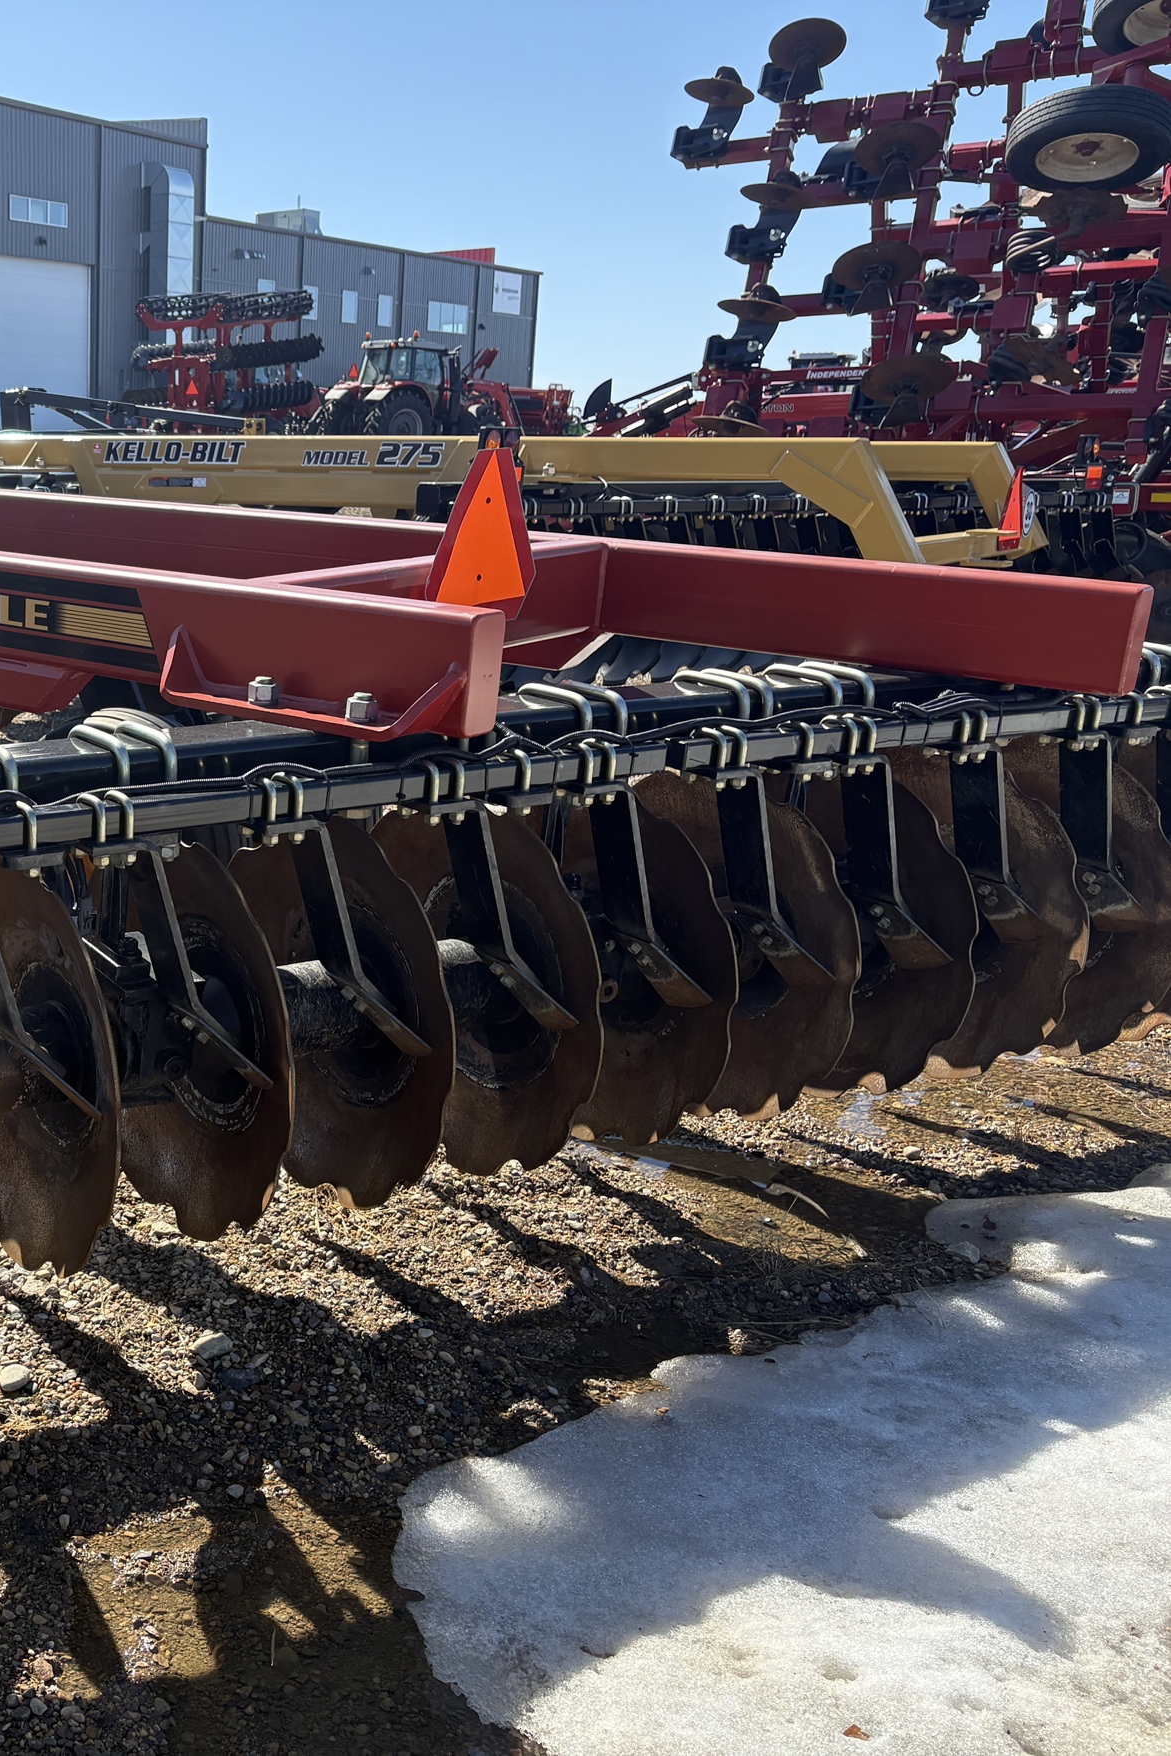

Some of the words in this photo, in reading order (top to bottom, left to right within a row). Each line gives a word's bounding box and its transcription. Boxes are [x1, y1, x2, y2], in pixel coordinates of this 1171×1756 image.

[806, 368, 869, 380] INDEPENDEN
[103, 441, 247, 465] KELLO-BILT
[301, 450, 370, 467] MODEL
[374, 441, 445, 468] 275
